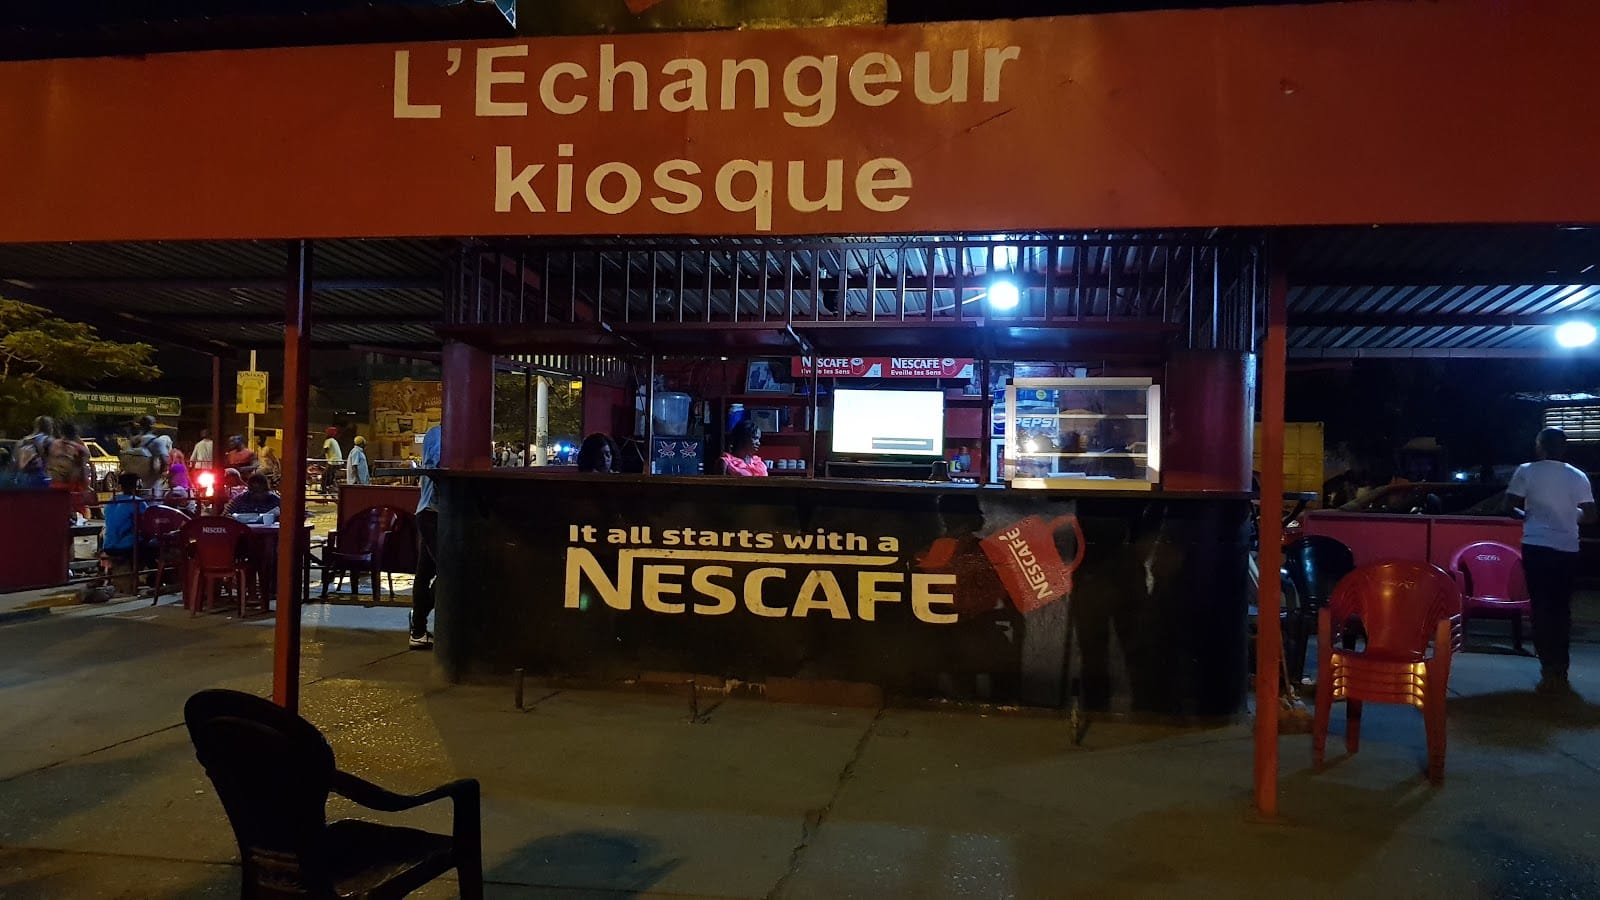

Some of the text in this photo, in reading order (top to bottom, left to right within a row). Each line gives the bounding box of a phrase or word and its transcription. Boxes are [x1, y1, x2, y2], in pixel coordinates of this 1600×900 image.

[494, 143, 913, 231] kiosque
[1015, 417, 1057, 427] PEPSI
[569, 524, 899, 552] It all starts with a
